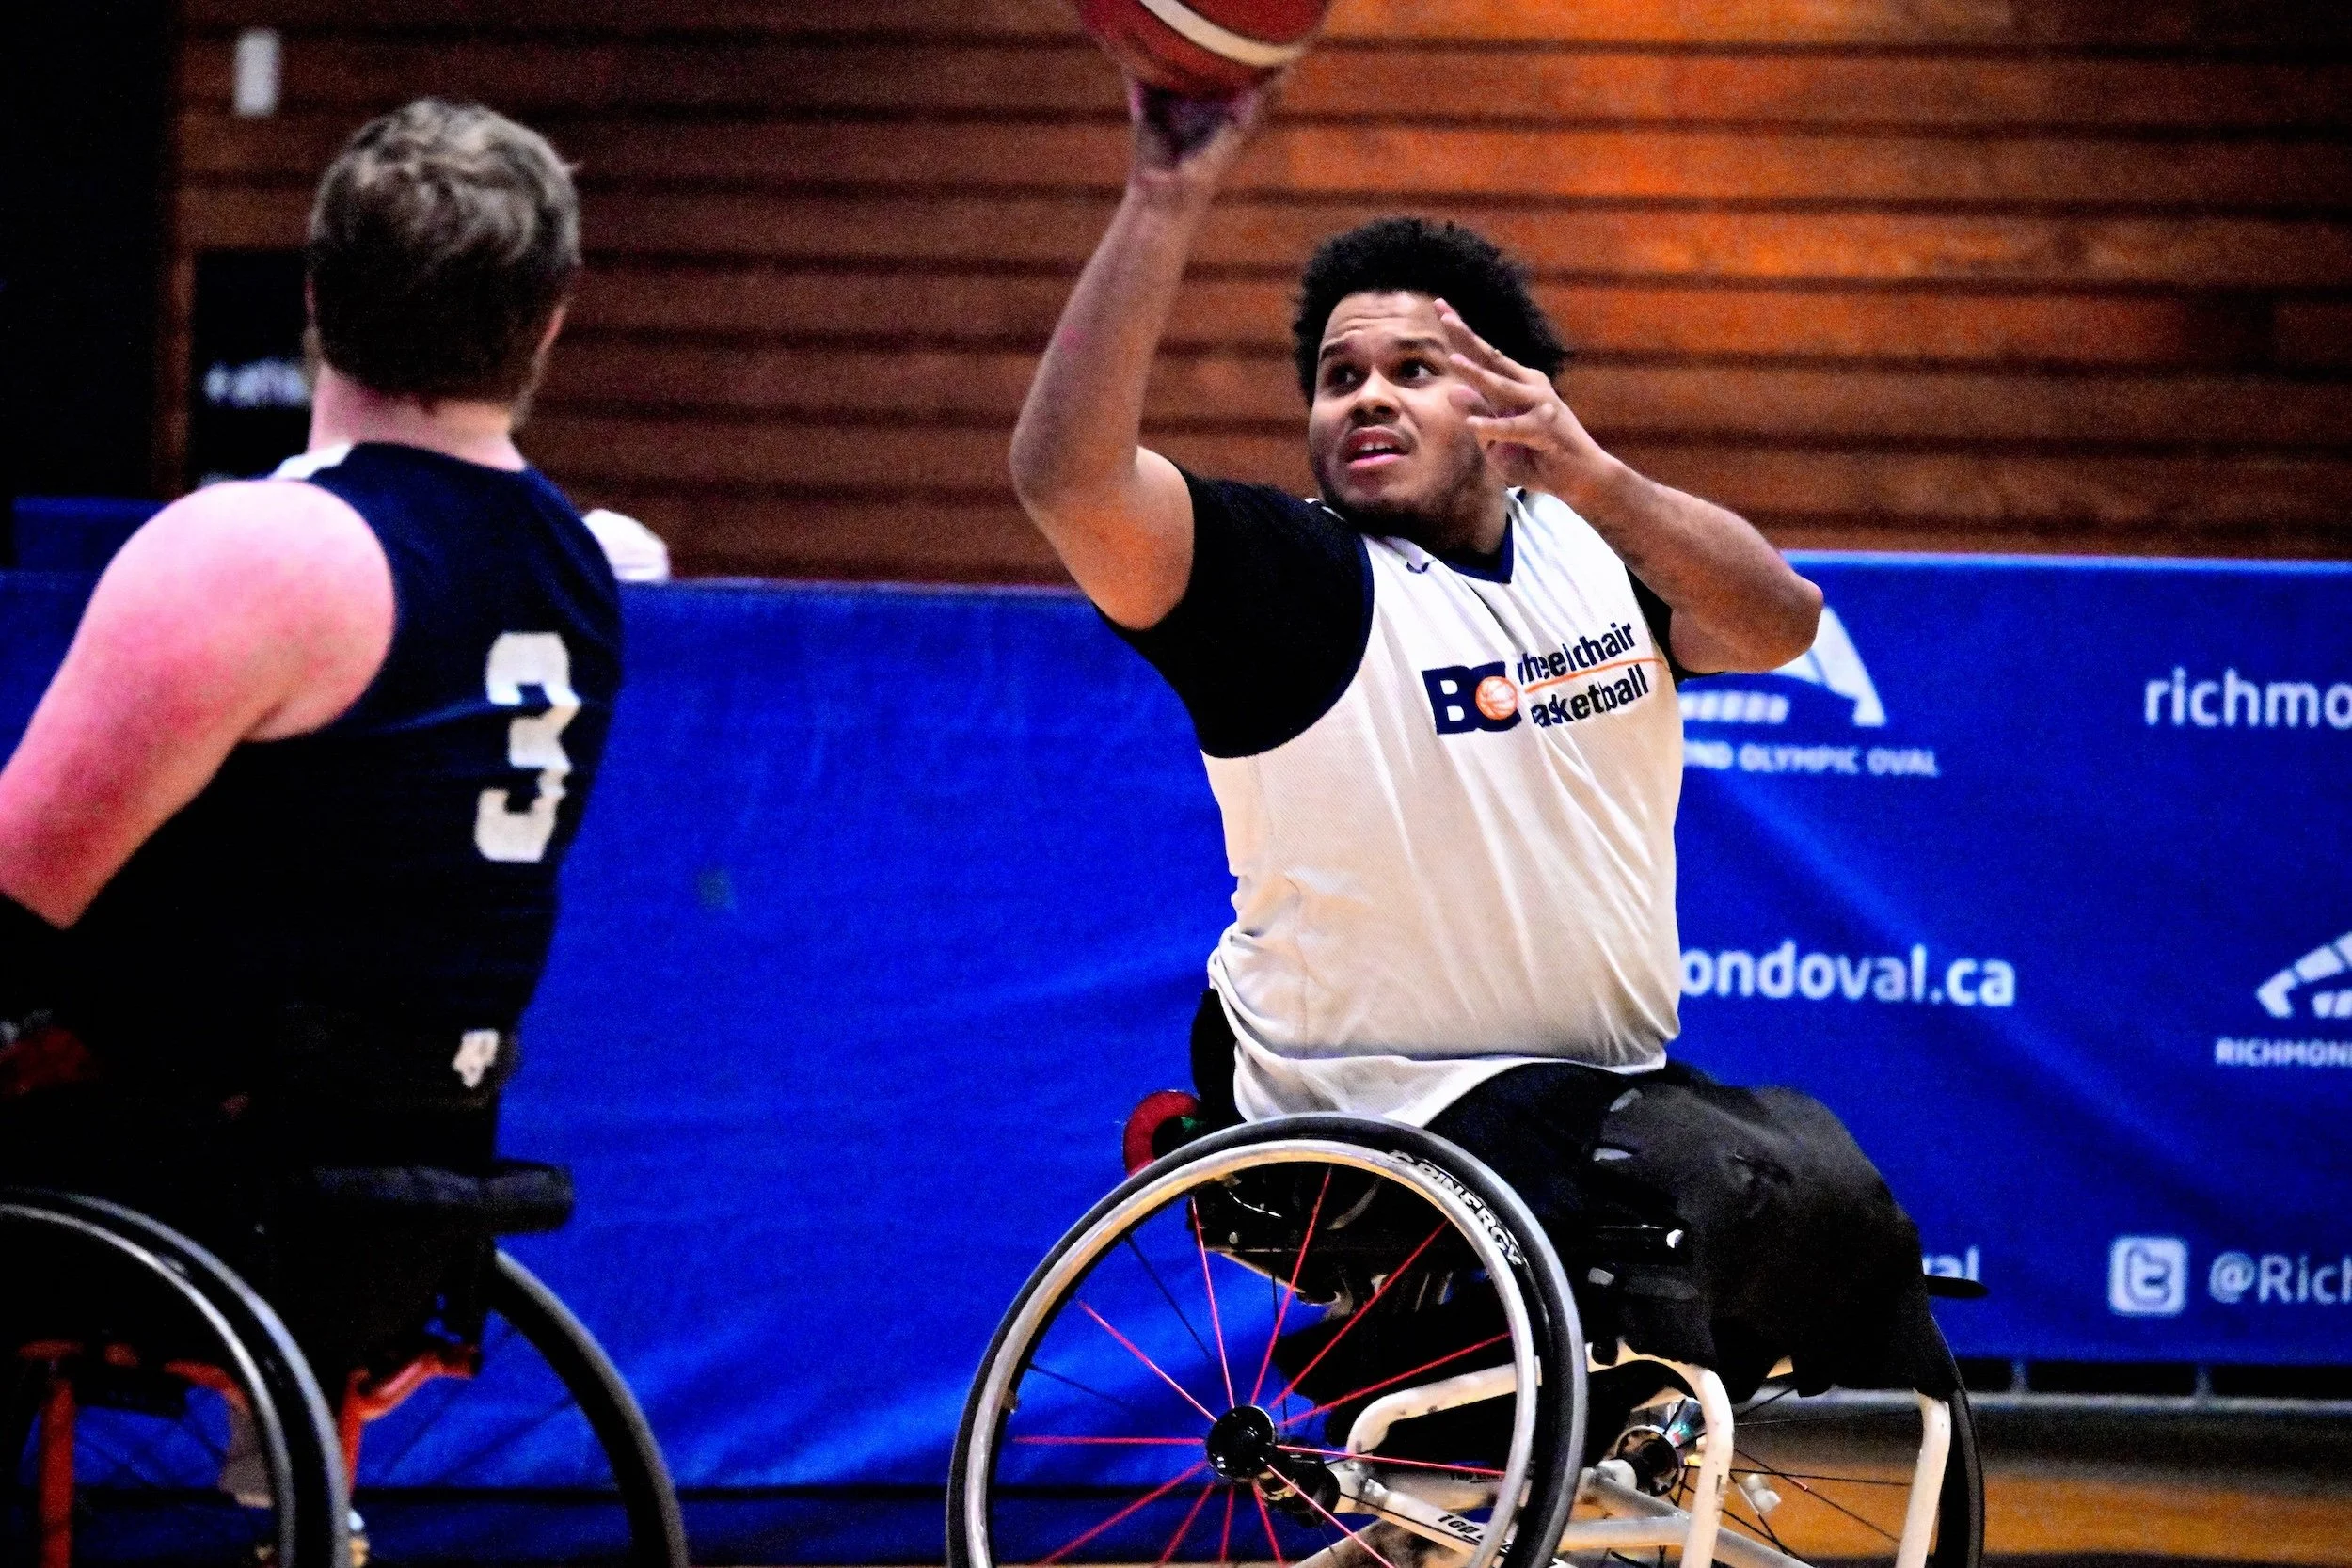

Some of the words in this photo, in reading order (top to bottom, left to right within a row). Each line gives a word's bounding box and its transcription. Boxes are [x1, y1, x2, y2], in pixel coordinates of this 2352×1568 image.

[1530, 663, 1649, 728] asketball
[474, 630, 581, 863] 3
[1740, 743, 1859, 774] OLYMPIC
[1867, 747, 1939, 777] OVAL
